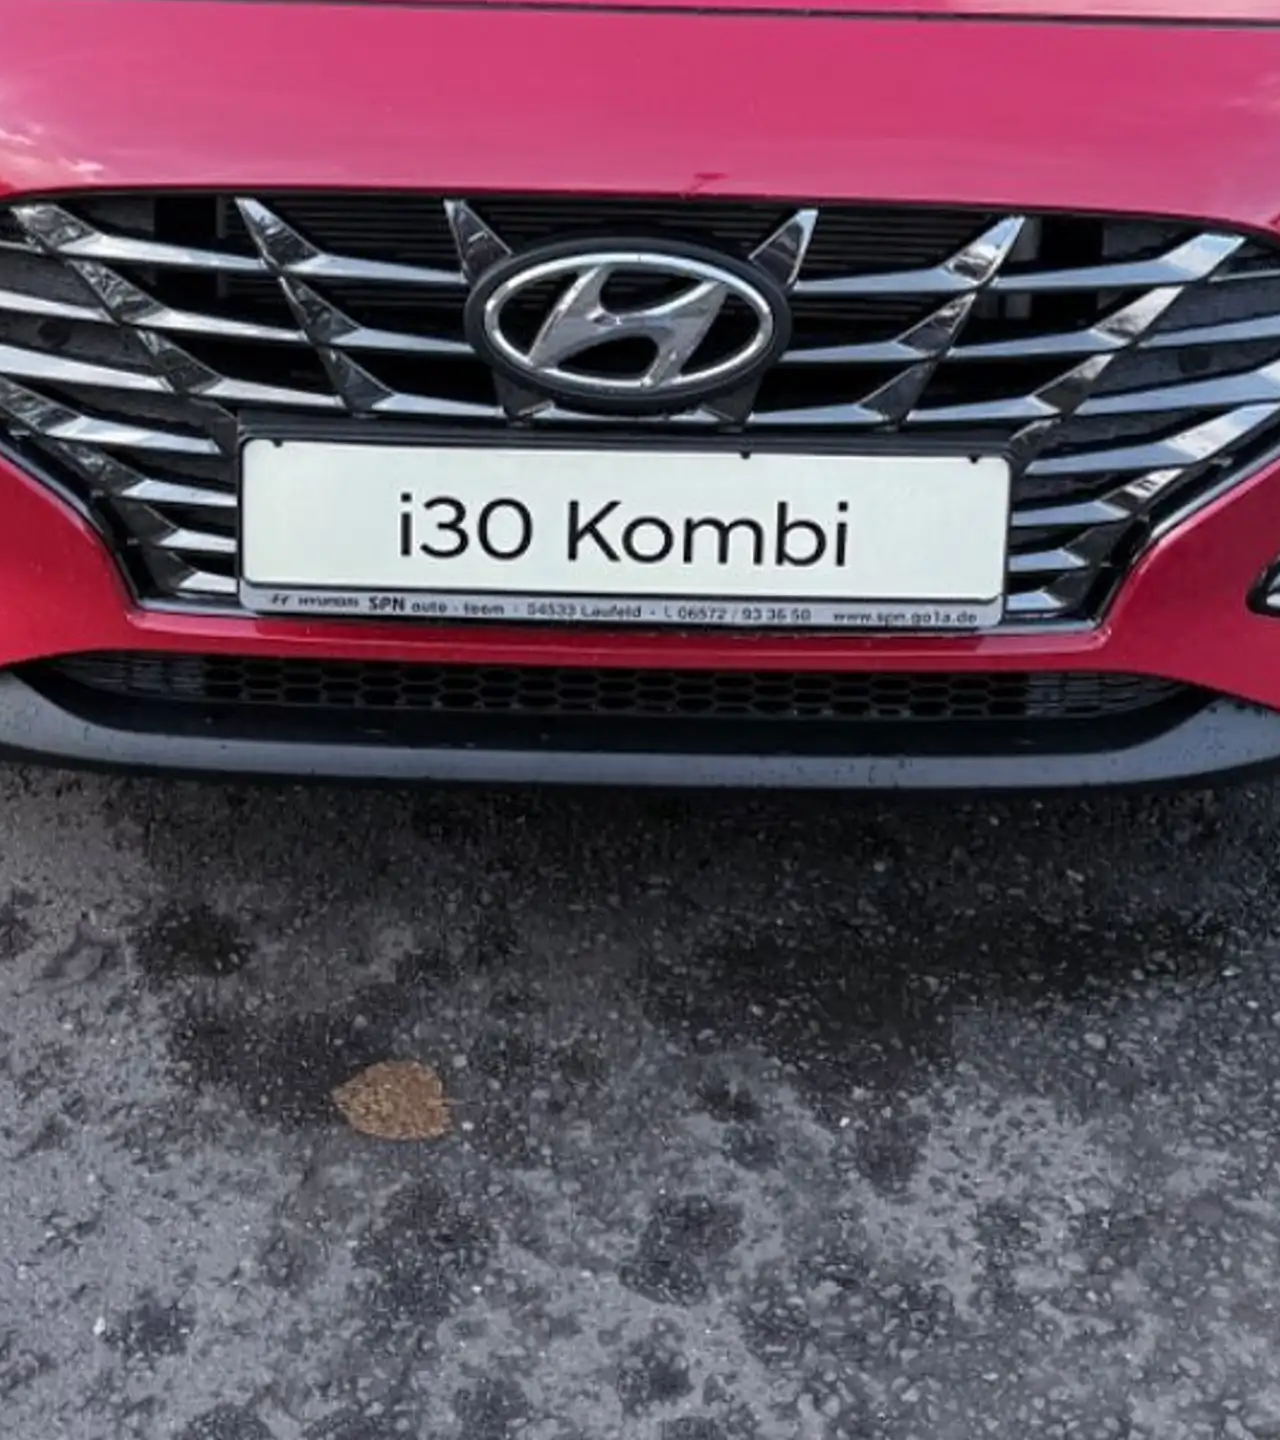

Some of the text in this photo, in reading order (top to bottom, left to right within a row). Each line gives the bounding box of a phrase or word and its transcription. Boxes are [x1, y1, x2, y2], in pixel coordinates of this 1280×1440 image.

[399, 491, 850, 568] i30 Kombi
[368, 595, 407, 613] SPN
